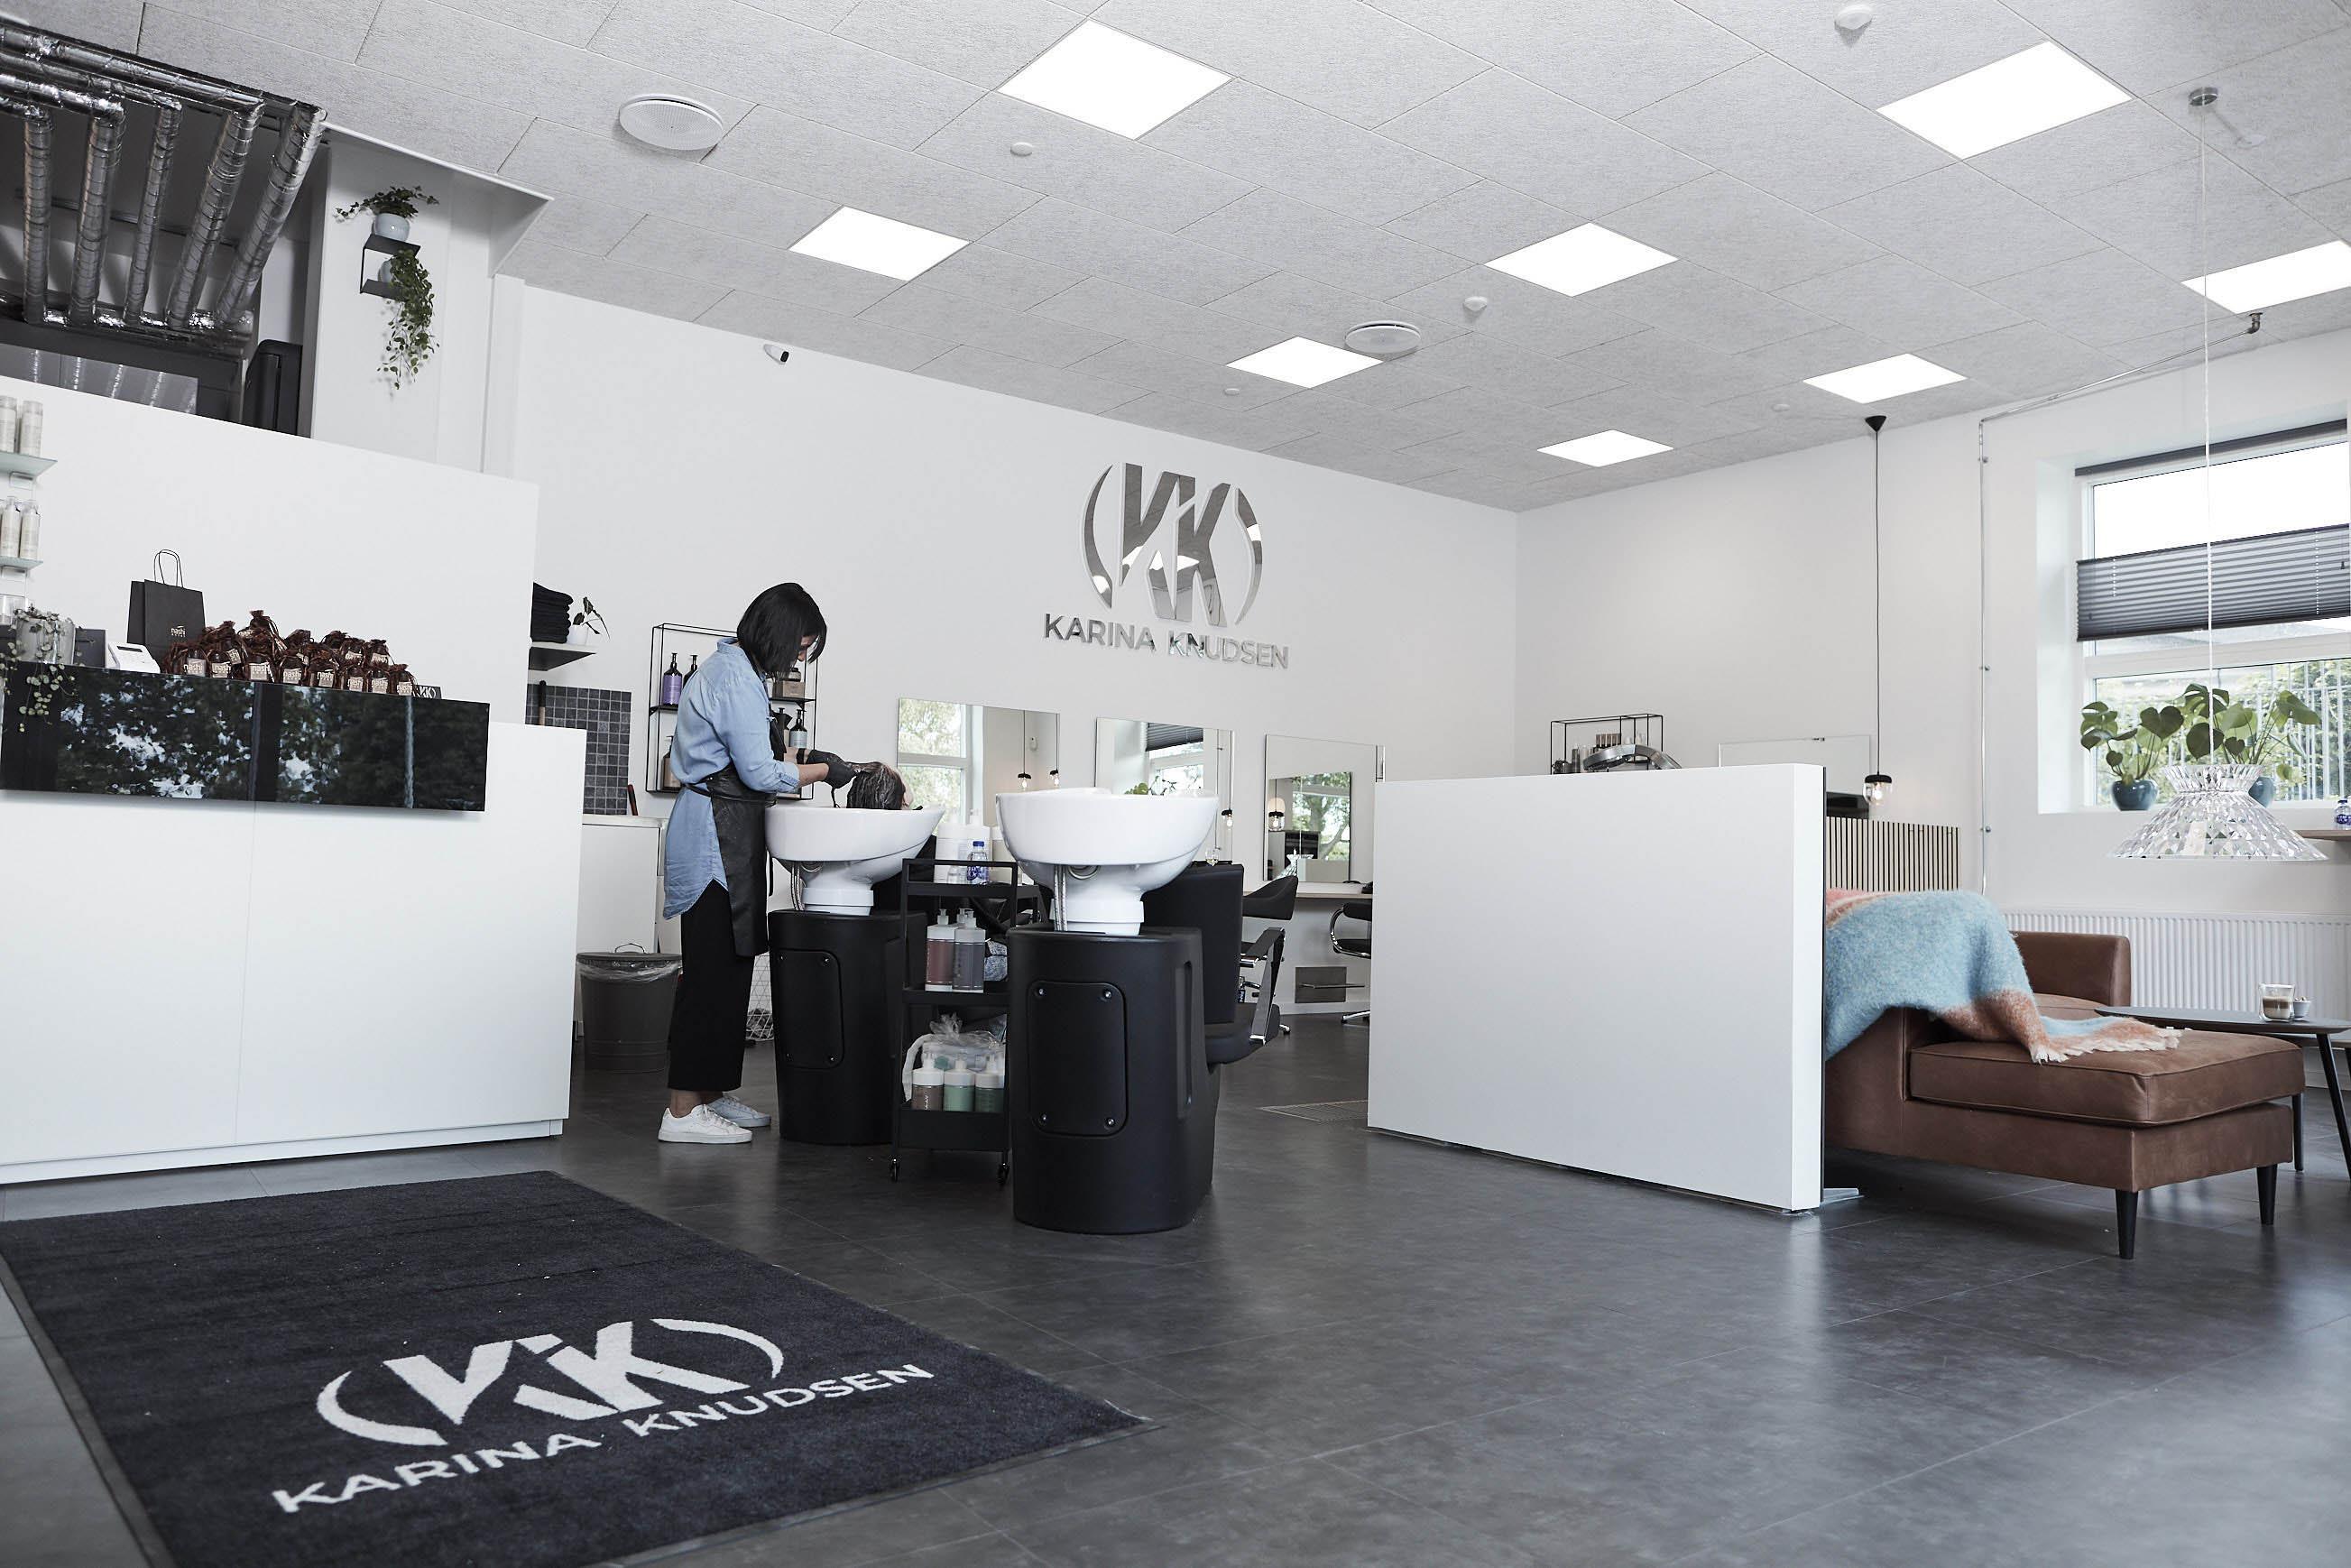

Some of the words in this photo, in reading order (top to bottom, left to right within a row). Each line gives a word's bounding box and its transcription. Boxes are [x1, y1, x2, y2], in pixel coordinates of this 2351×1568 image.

[183, 663, 203, 671] nashi
[1044, 613, 1157, 652] KARINA
[1167, 630, 1290, 669] KNUDSEN
[272, 1432, 603, 1515] KARINA
[622, 1363, 936, 1438] KNUDSEN
